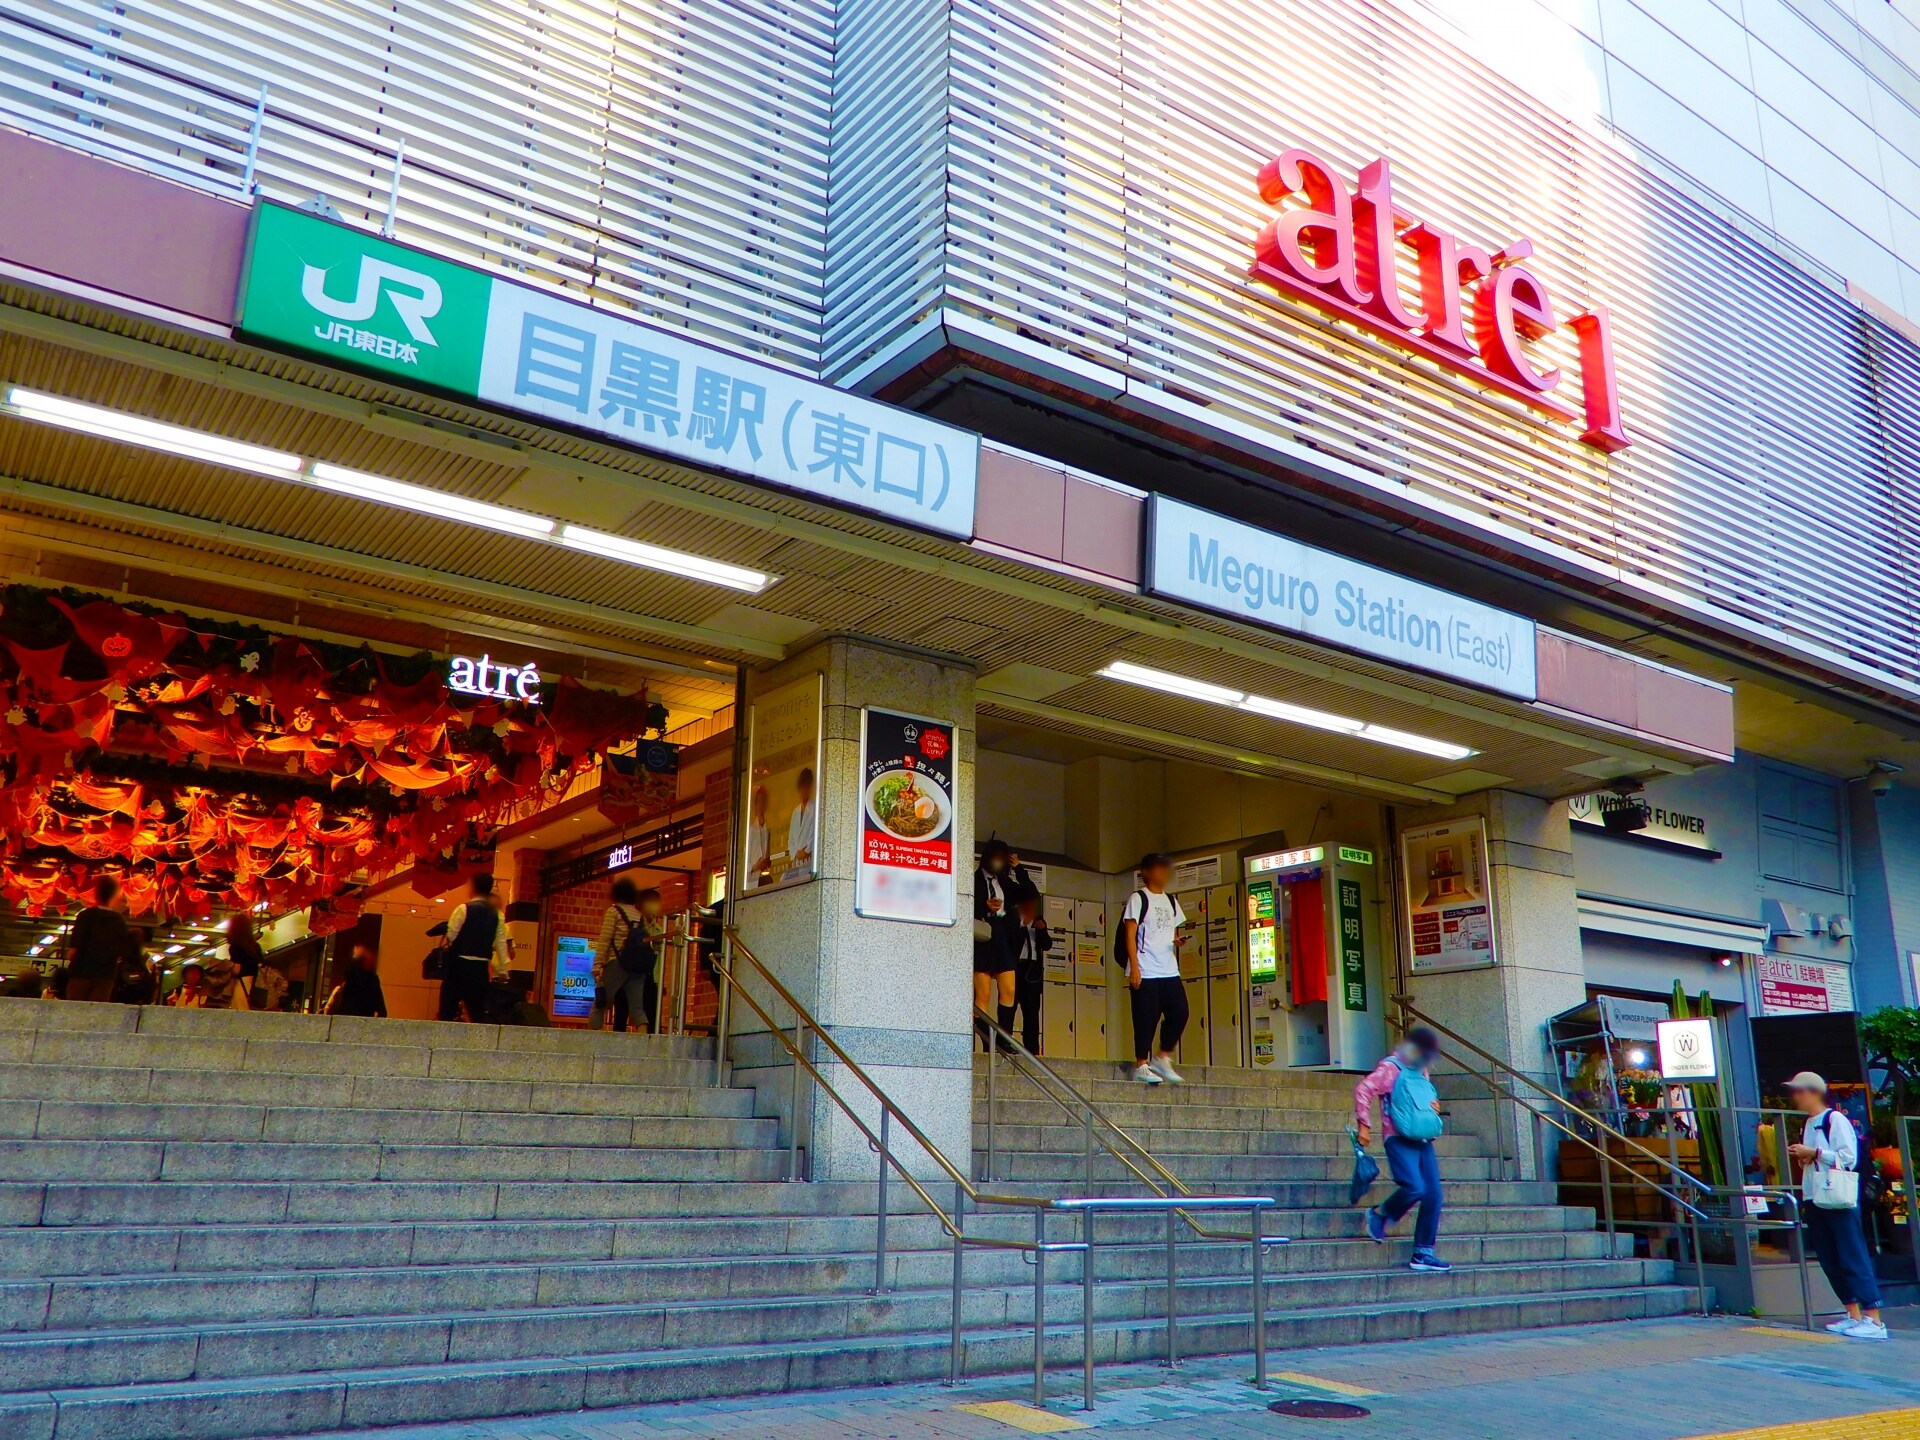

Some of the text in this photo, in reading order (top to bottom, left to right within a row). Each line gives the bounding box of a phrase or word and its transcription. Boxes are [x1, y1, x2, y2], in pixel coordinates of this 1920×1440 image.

[1256, 148, 1561, 392] atré
[302, 254, 439, 347] JR
[314, 321, 419, 365] JR東日本
[1188, 532, 1512, 676] Meguro Station (East)
[449, 653, 541, 700] atré
[1655, 808, 1705, 834] FLOWER
[1260, 850, 1313, 870] 証明写真
[1341, 849, 1370, 863] 証明写真
[1342, 885, 1364, 1007] 証明写真
[1768, 958, 1793, 978] atré
[1799, 965, 1825, 984] 駐輪場
[1621, 1013, 1641, 1022] WONDER
